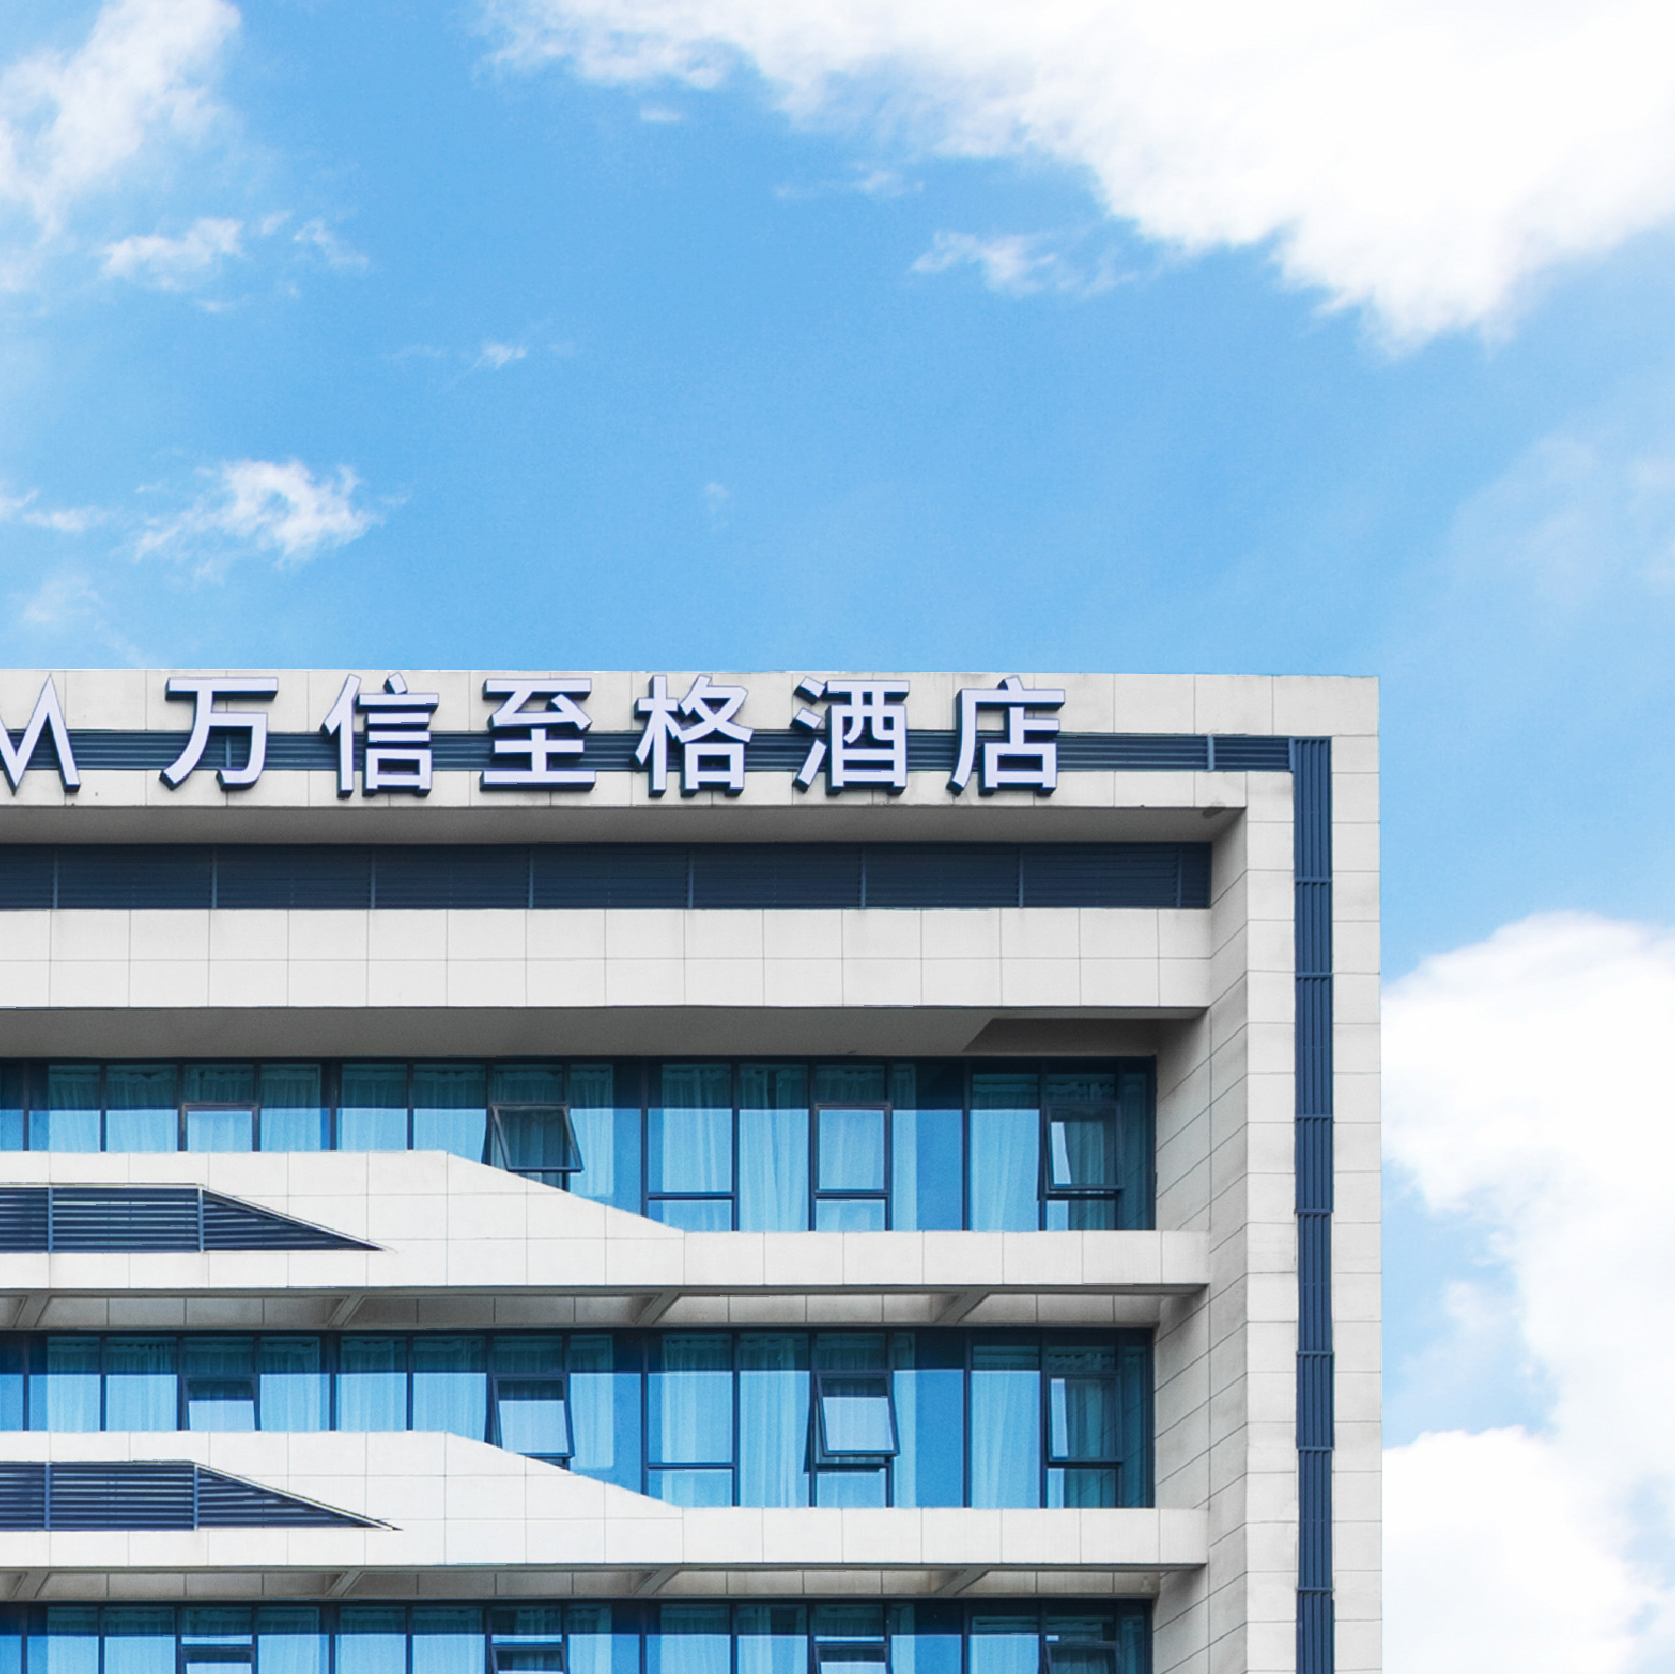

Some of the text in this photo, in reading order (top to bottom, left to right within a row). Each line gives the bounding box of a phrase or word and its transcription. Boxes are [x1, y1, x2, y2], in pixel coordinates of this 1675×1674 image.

[159, 670, 1066, 798] 万信至格酒店
